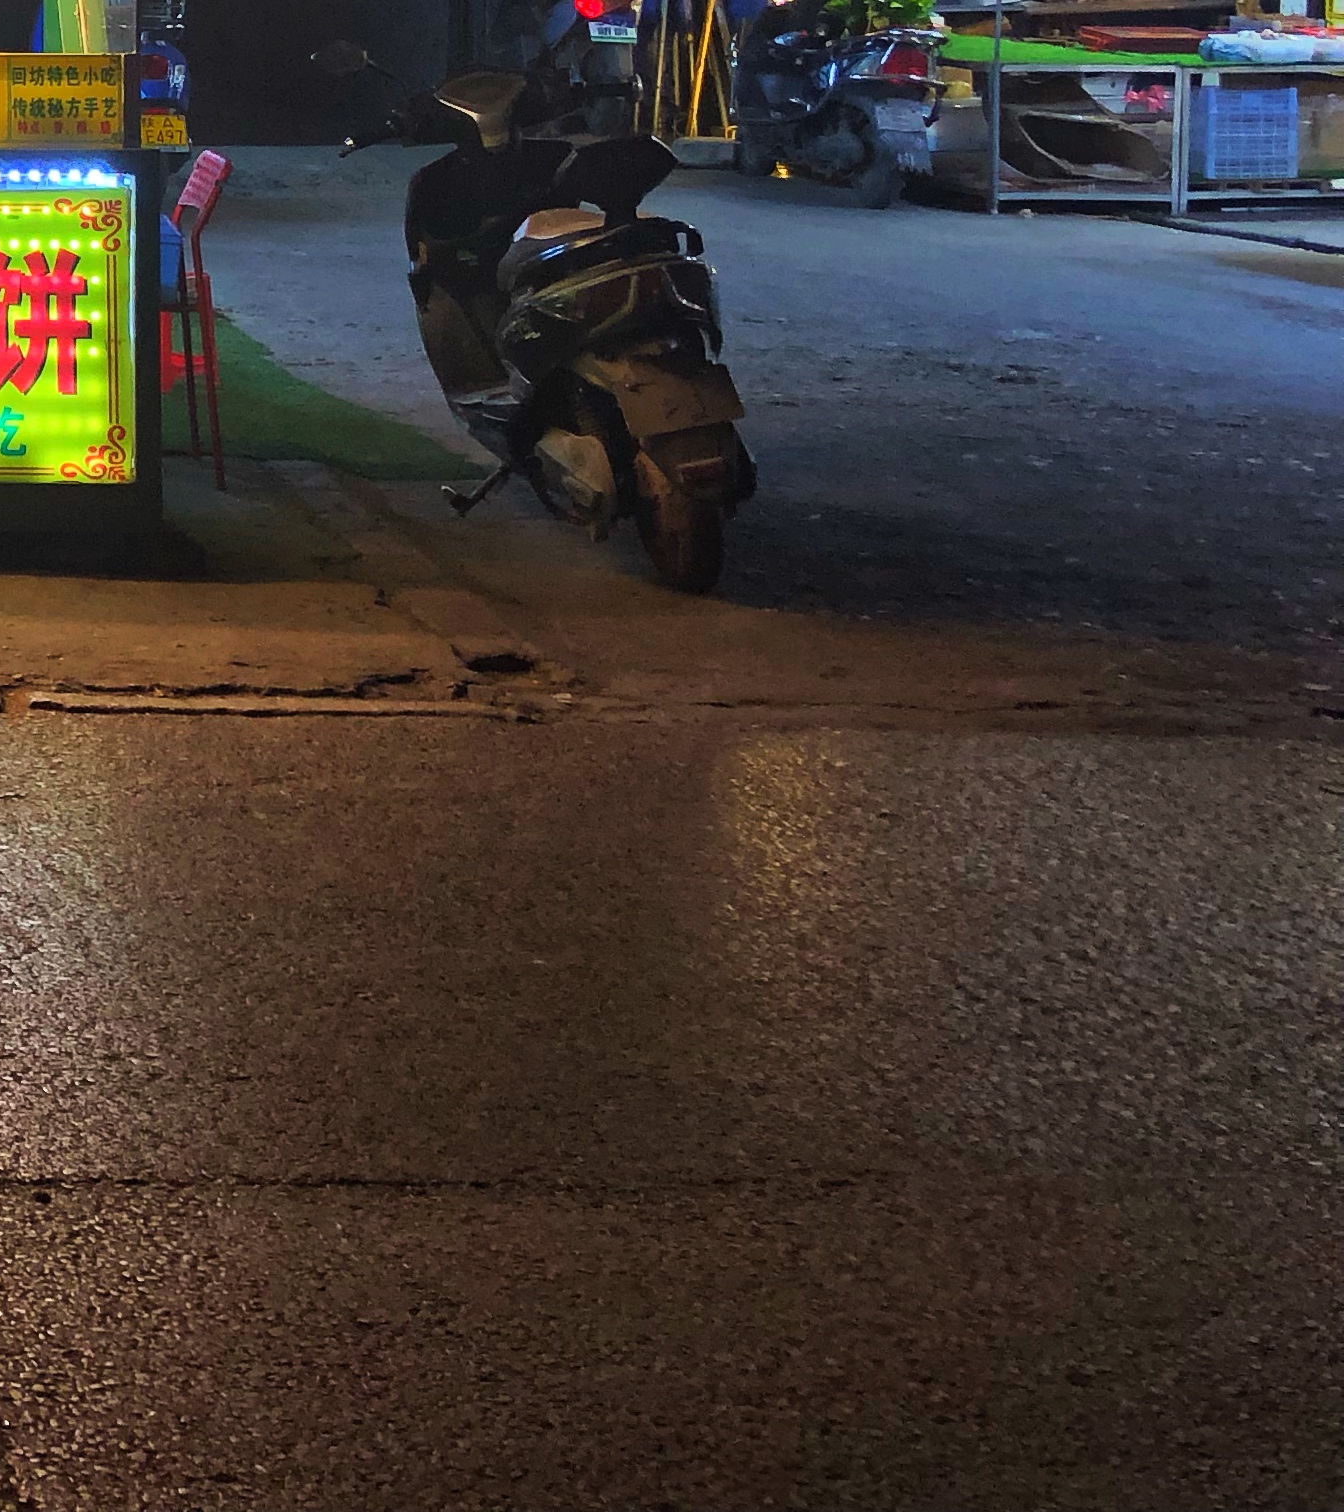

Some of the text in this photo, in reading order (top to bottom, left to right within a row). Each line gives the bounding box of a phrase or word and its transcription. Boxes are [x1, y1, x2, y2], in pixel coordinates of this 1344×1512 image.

[12, 65, 116, 88] 回坊特色小吃
[12, 96, 116, 119] 传统秘方手艺
